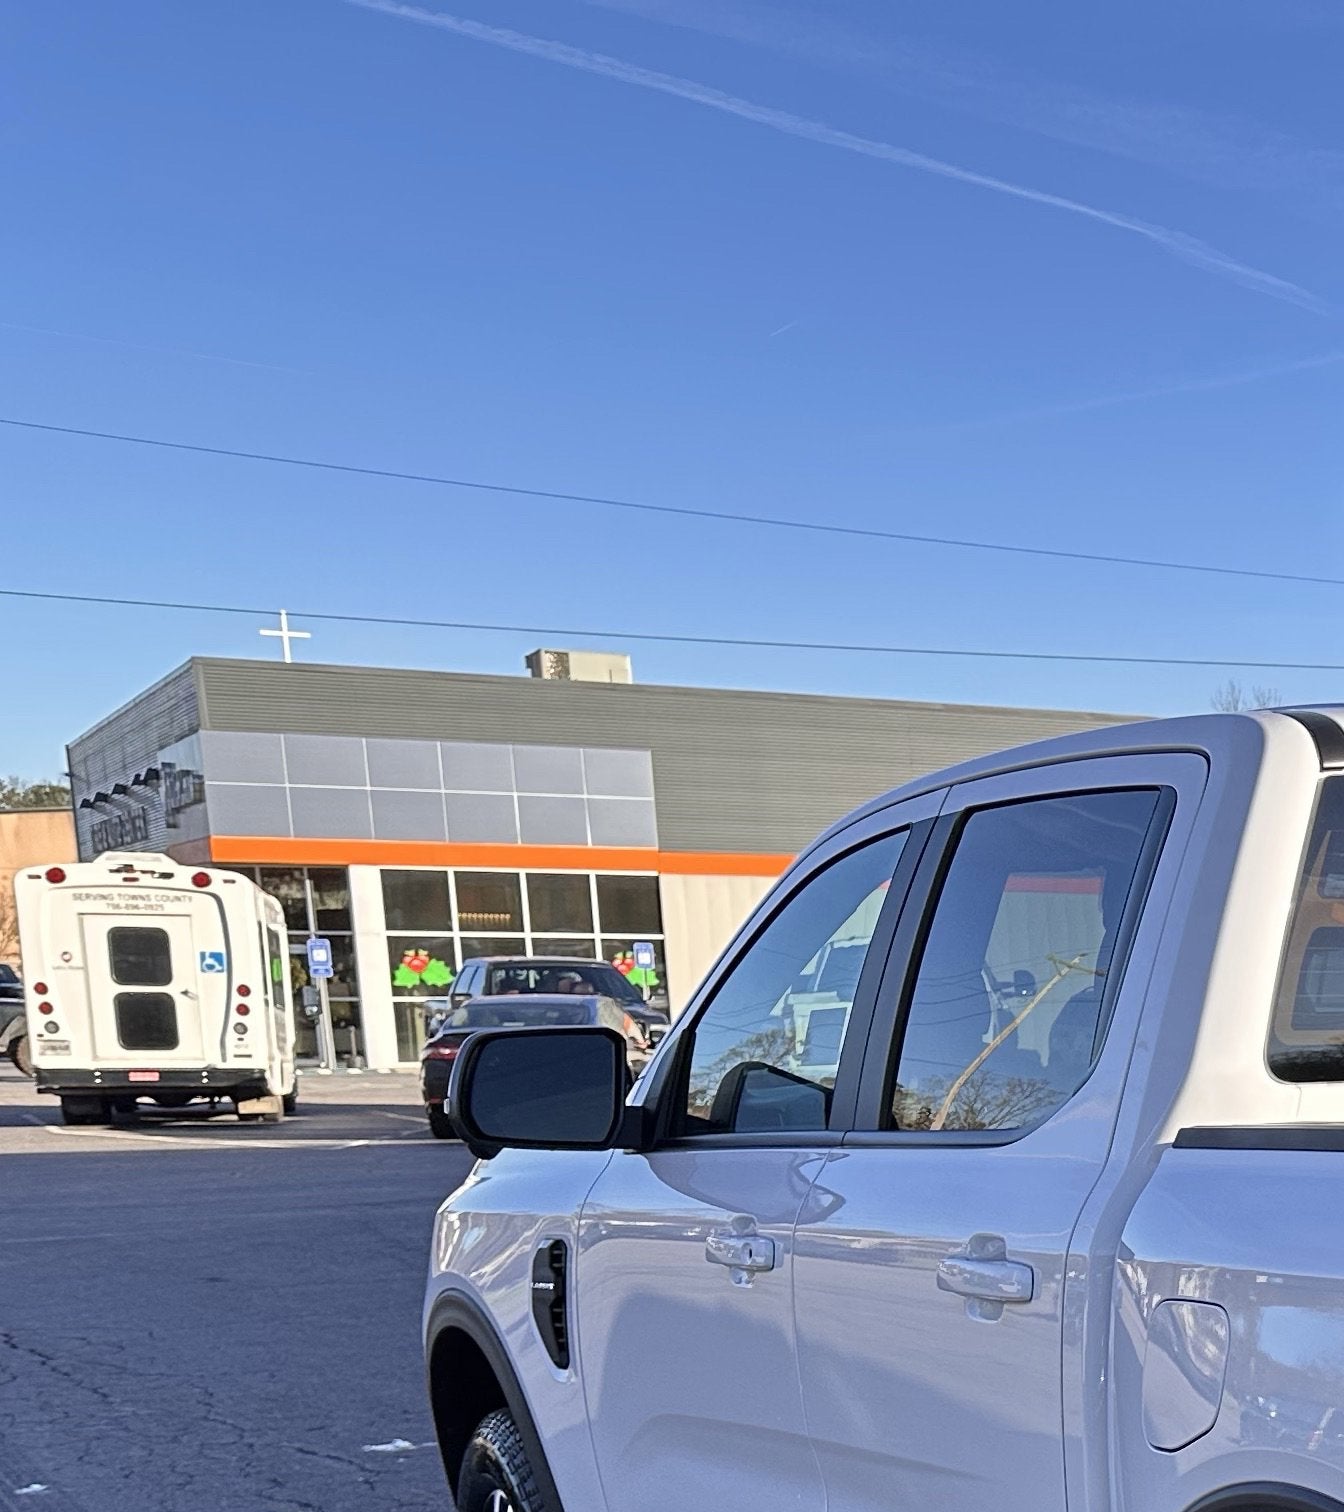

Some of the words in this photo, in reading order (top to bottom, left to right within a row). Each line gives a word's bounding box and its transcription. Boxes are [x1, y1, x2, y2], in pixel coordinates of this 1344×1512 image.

[72, 893, 114, 901] SERVING
[117, 893, 152, 902] TOWNS
[154, 894, 193, 903] COUNTY
